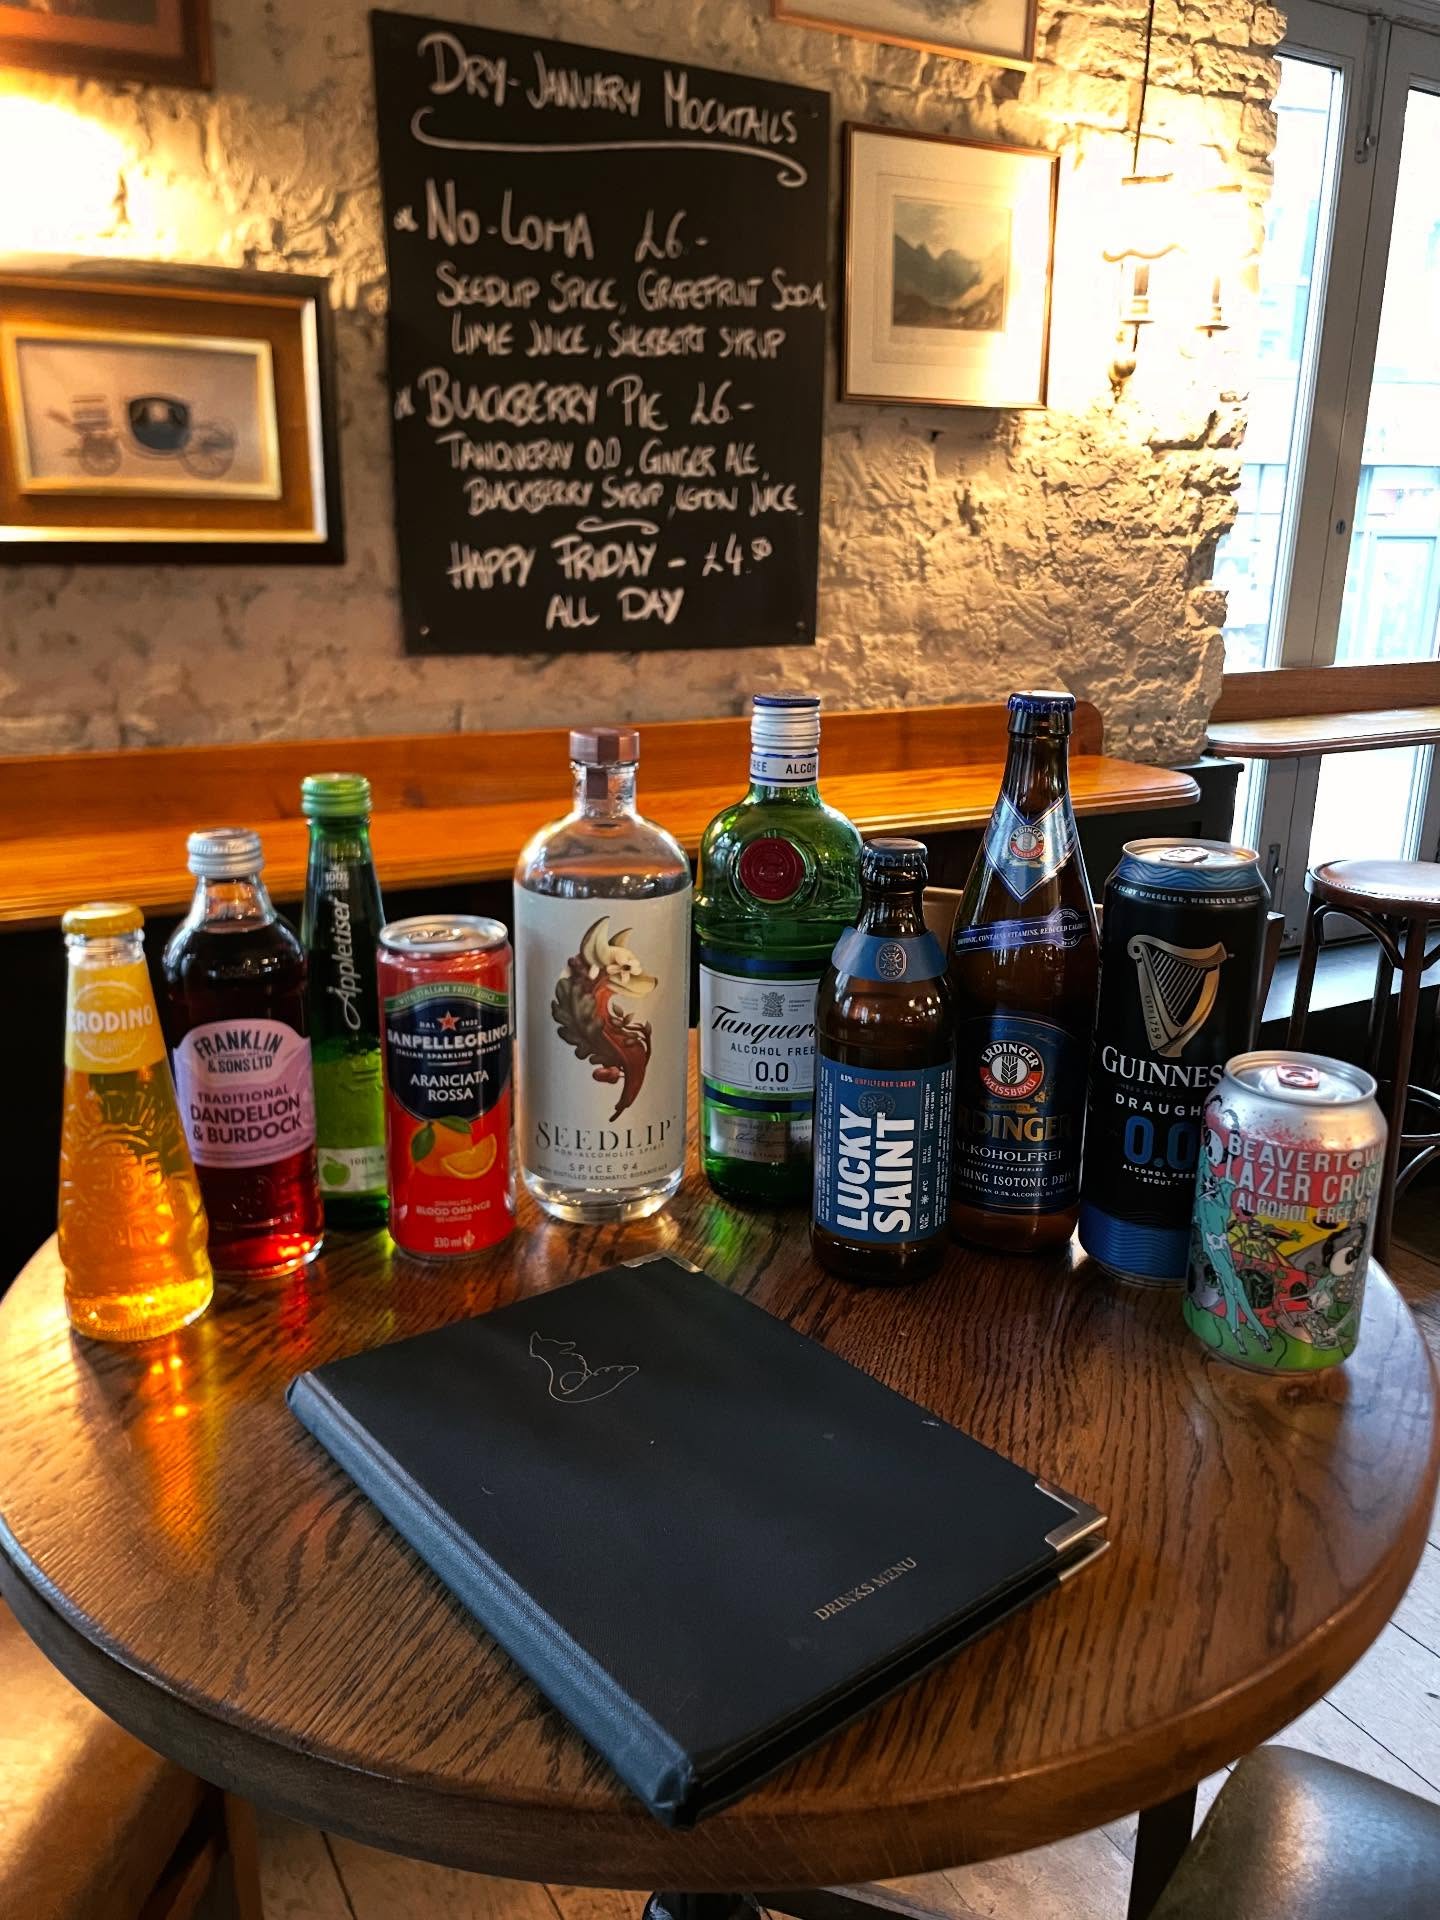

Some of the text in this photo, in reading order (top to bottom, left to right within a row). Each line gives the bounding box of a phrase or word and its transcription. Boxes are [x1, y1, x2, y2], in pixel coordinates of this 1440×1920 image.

[664, 69, 797, 144] MOCKTAILS
[637, 267, 764, 312] GRAPEFRUIT
[771, 267, 828, 312] SODA
[451, 311, 514, 356] LIME
[719, 327, 787, 360] SYRUP
[418, 367, 599, 428] BLACKBERRY
[607, 373, 669, 431] PIE
[435, 431, 574, 471] TANQUERAY
[638, 437, 718, 477] GINGER
[463, 475, 593, 517] BLACKBERRY
[446, 541, 536, 590] HAPPY
[551, 533, 658, 580] FRIDAY
[545, 585, 685, 631] ALL DAY
[785, 763, 816, 774] ALCO
[329, 898, 363, 1031] Appletiser
[711, 1005, 816, 1045] Tanquer
[1148, 1016, 1162, 1040] 1759
[193, 1029, 284, 1060] FRANKLIN
[730, 1042, 816, 1056] ALCOHOL FREE
[981, 1042, 1040, 1068] ERDINGER
[207, 1055, 273, 1073] & SONS LTD
[410, 1069, 490, 1087] ARANCIATA
[755, 1061, 789, 1083] 0.0
[1102, 1045, 1224, 1089] GUINNES
[198, 1083, 289, 1104] TRADITIONAL
[428, 1087, 474, 1102] ROSSA
[895, 1080, 917, 1088] LAGER
[190, 1092, 301, 1125] DANDELION
[1115, 1092, 1201, 1117] DRAUGH
[193, 1113, 303, 1144] & BURDOCK
[535, 1119, 671, 1151] SEEDLIP
[1124, 1115, 1199, 1171] 0.0
[554, 1148, 634, 1159] NON-ALCOHOLIC
[569, 1162, 639, 1173] SPICE 94
[836, 1103, 872, 1231] LUCKY
[956, 1142, 1062, 1162] LKOHOLFREI
[872, 1119, 915, 1233] SAINT
[993, 1175, 1048, 1188] ISOTONIC
[1122, 1163, 1168, 1178] ALCOHOL
[1143, 1177, 1172, 1186] STOUT
[1225, 1154, 1313, 1203] LAZER
[451, 1199, 491, 1214] ORANGE
[1236, 1193, 1309, 1223] ALCOHOL
[1316, 1205, 1353, 1224] FREE
[813, 1557, 918, 1621] DRINKS MENU
